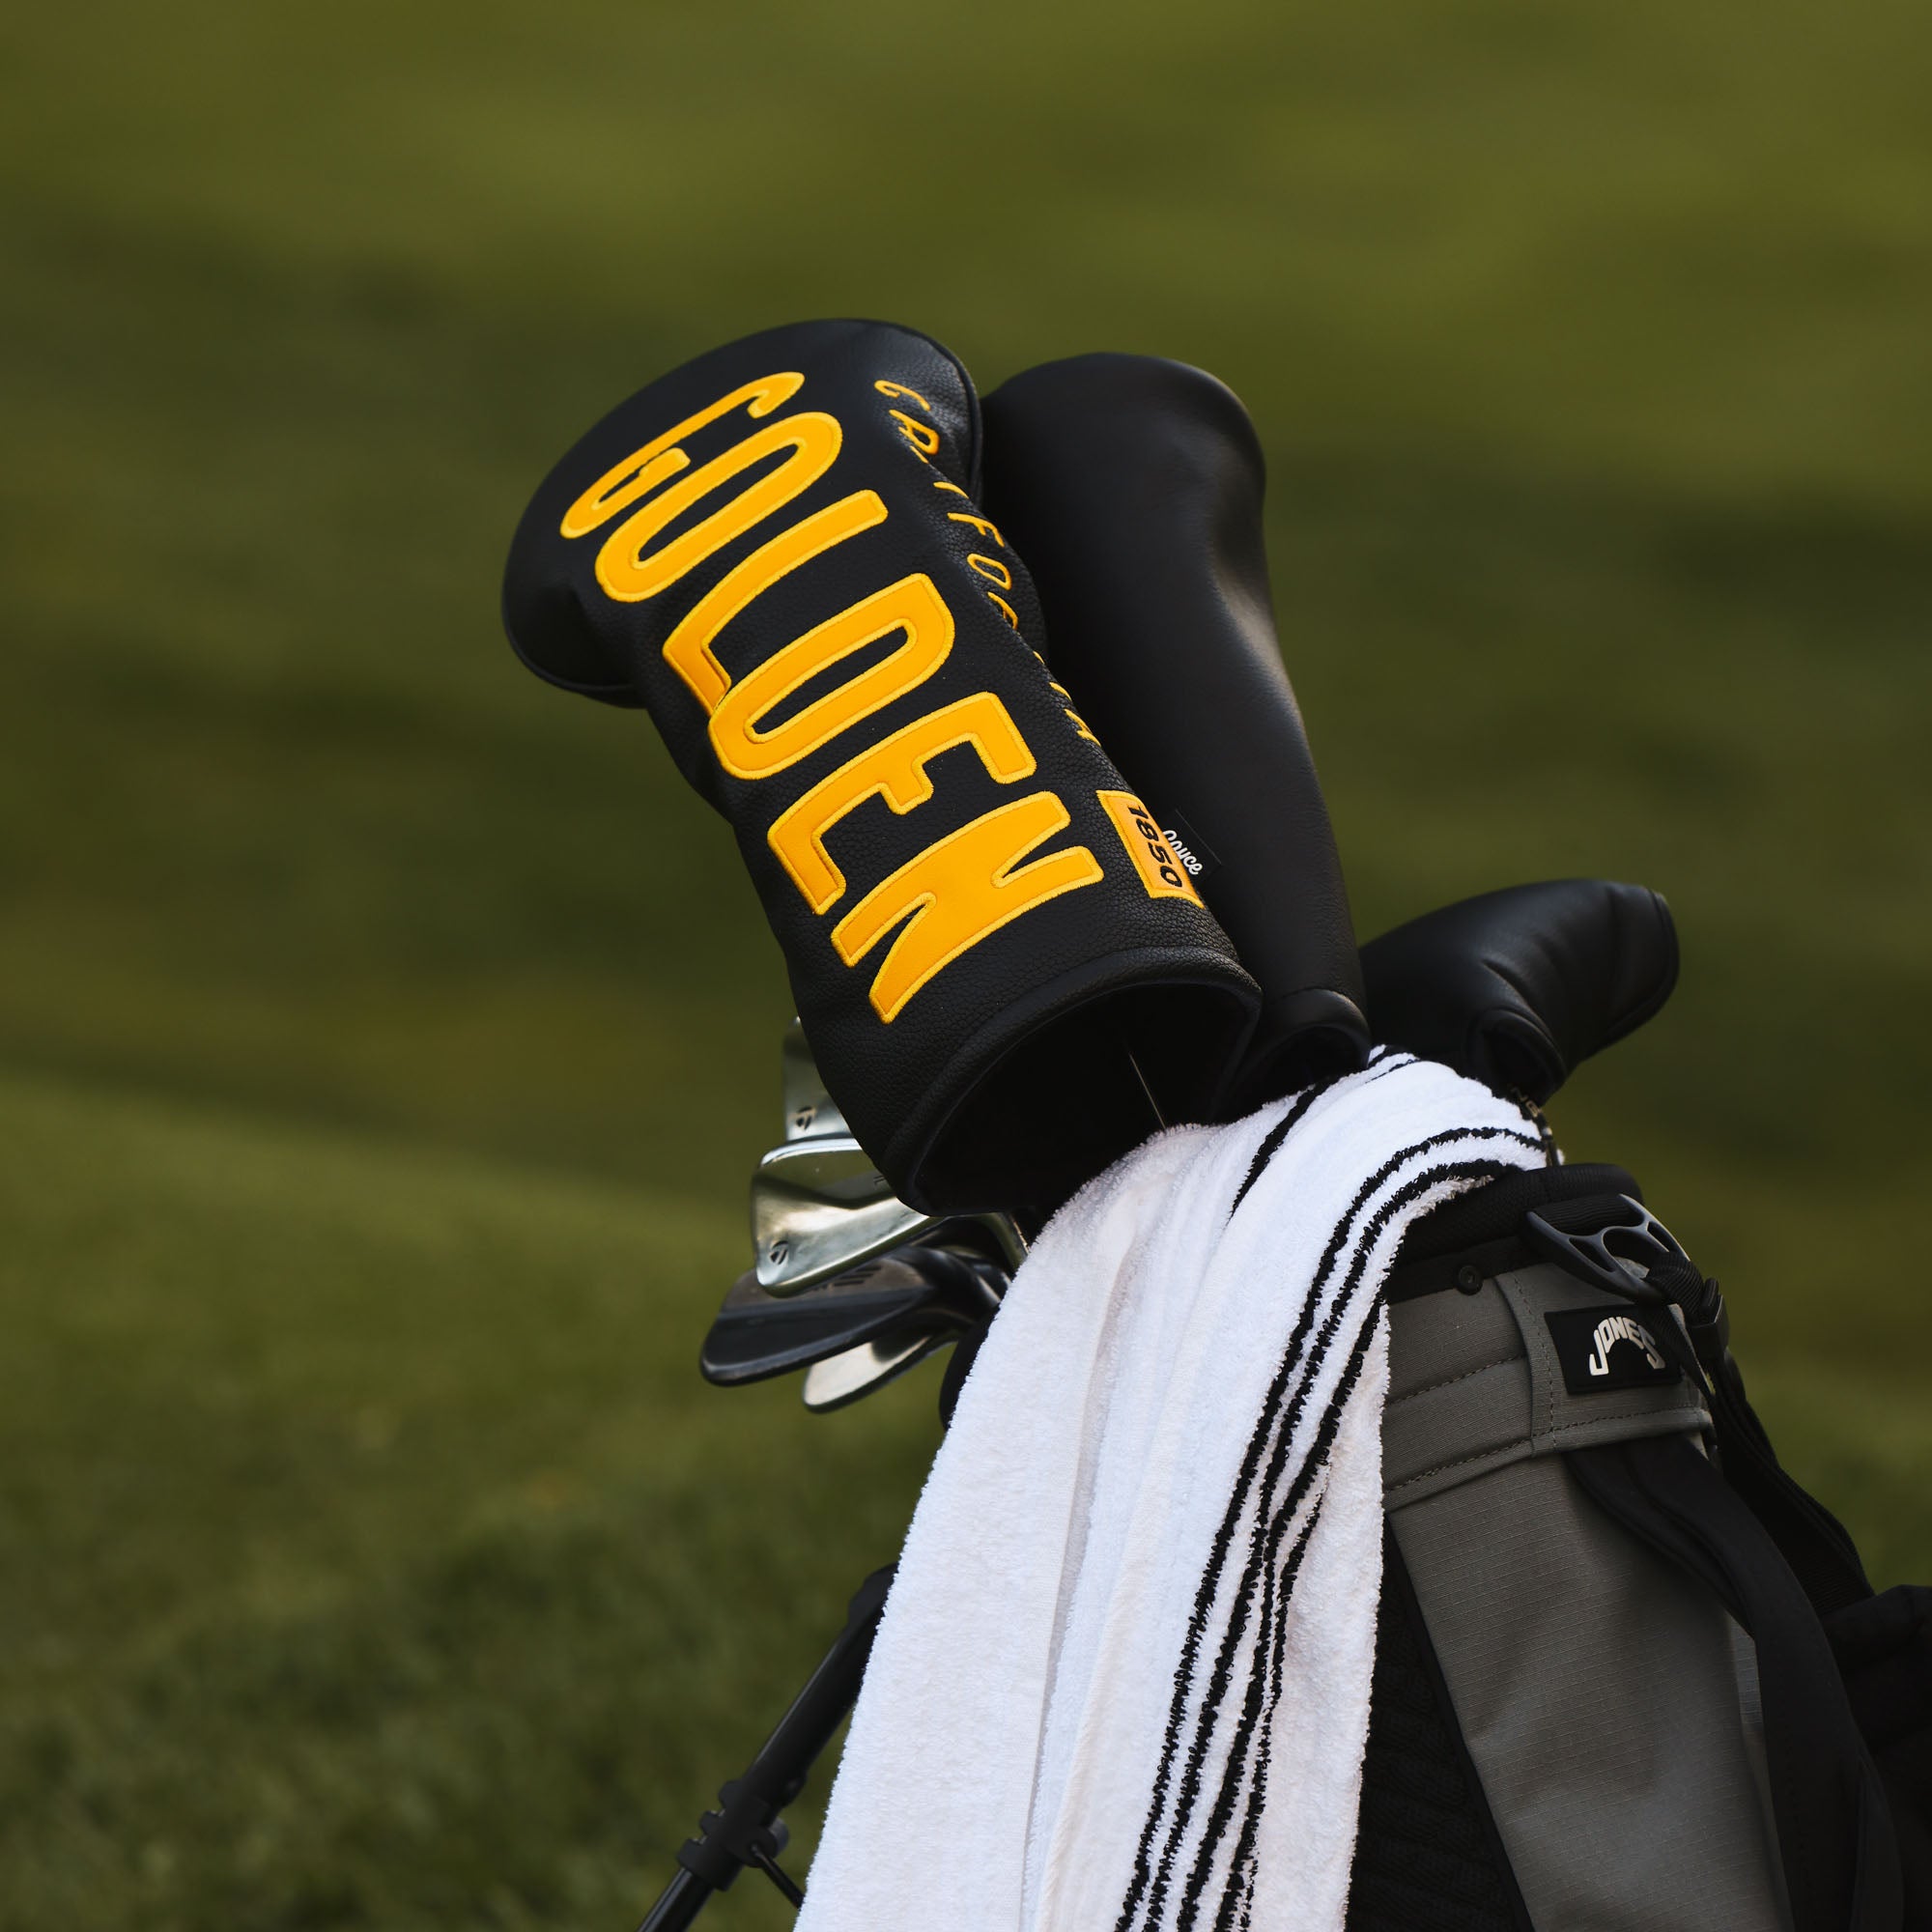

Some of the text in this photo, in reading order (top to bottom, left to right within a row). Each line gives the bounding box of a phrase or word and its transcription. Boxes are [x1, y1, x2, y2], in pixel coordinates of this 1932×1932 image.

[560, 371, 1104, 1024] GOLDEN
[1126, 804, 1182, 888] 1850
[1589, 1316, 1665, 1376] JONES
